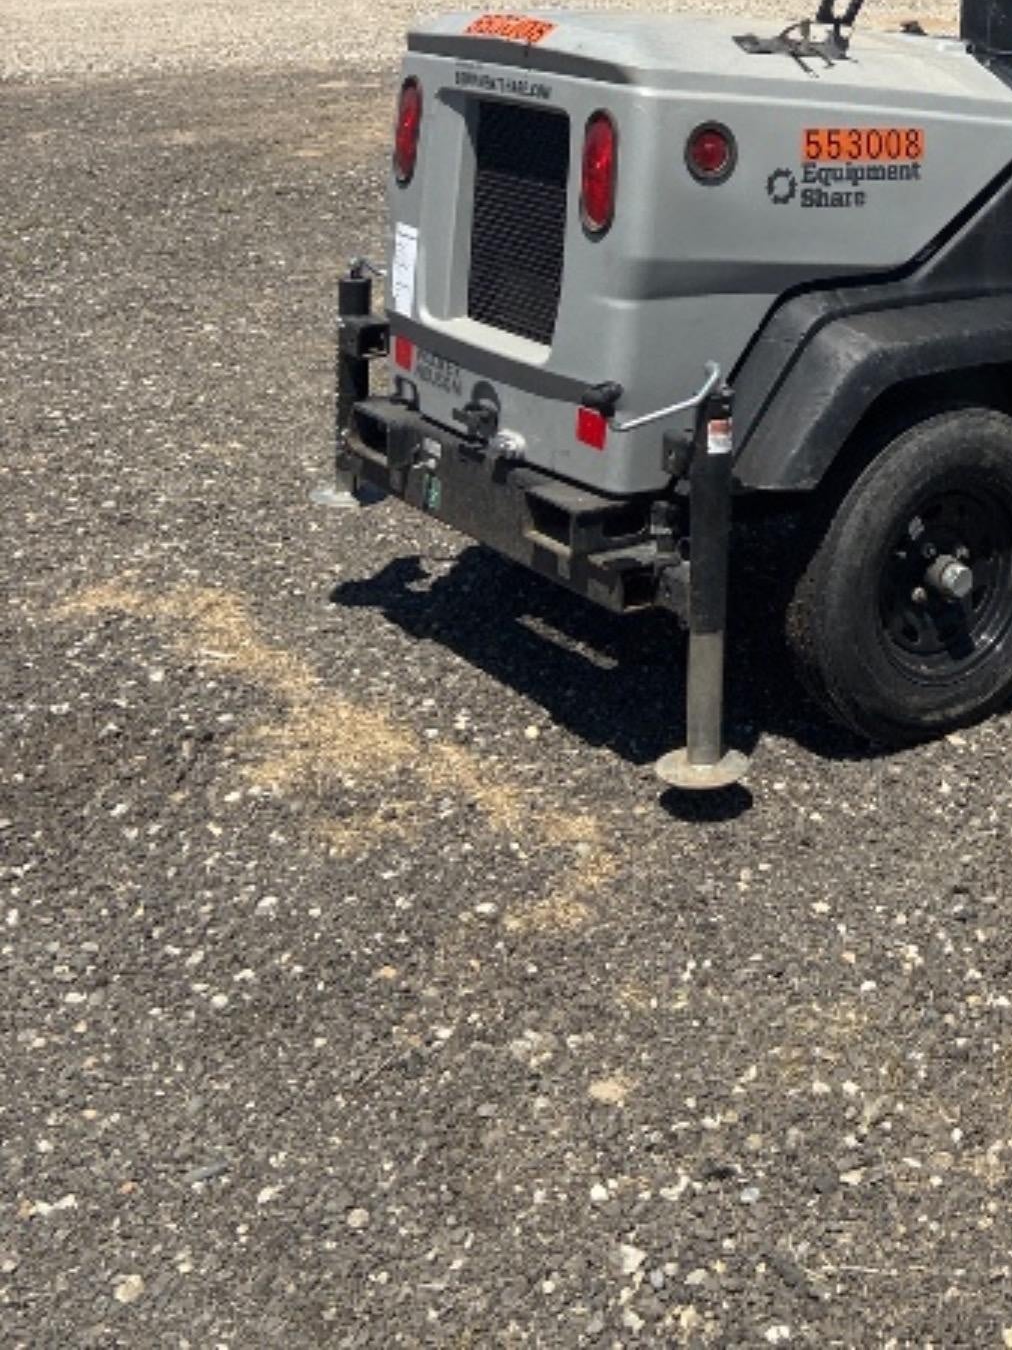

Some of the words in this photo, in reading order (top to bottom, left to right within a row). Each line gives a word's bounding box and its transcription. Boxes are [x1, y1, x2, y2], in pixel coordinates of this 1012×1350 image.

[806, 129, 922, 159] 553008
[801, 161, 921, 185] Equipment
[801, 188, 866, 208] Share
